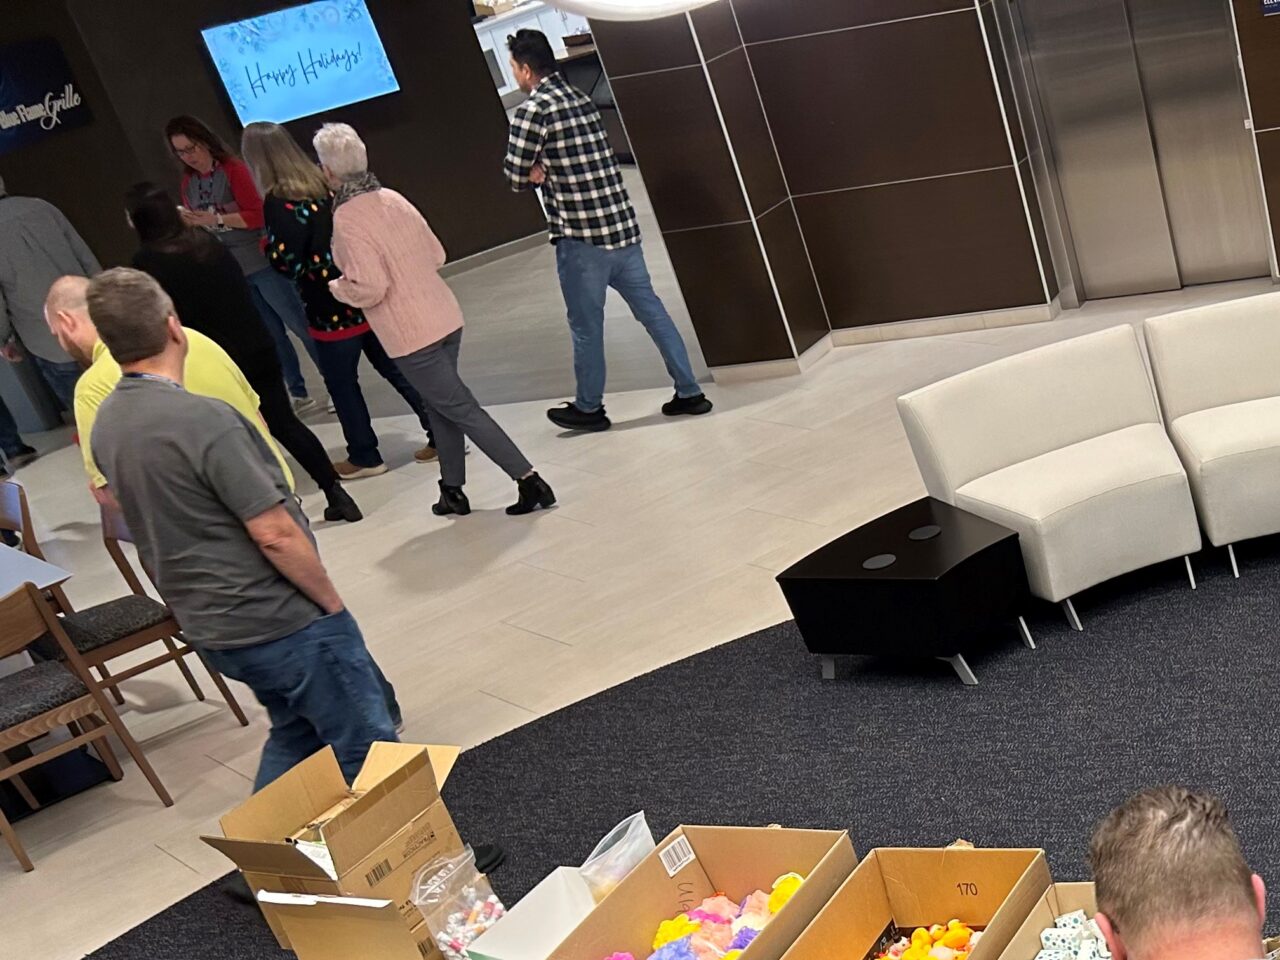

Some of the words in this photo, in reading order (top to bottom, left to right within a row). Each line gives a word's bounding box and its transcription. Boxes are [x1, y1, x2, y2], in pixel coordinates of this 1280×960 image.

[245, 62, 297, 99] Happy
[297, 42, 363, 85] Holidays!
[40, 83, 81, 130] Grille
[956, 882, 978, 896] 170
